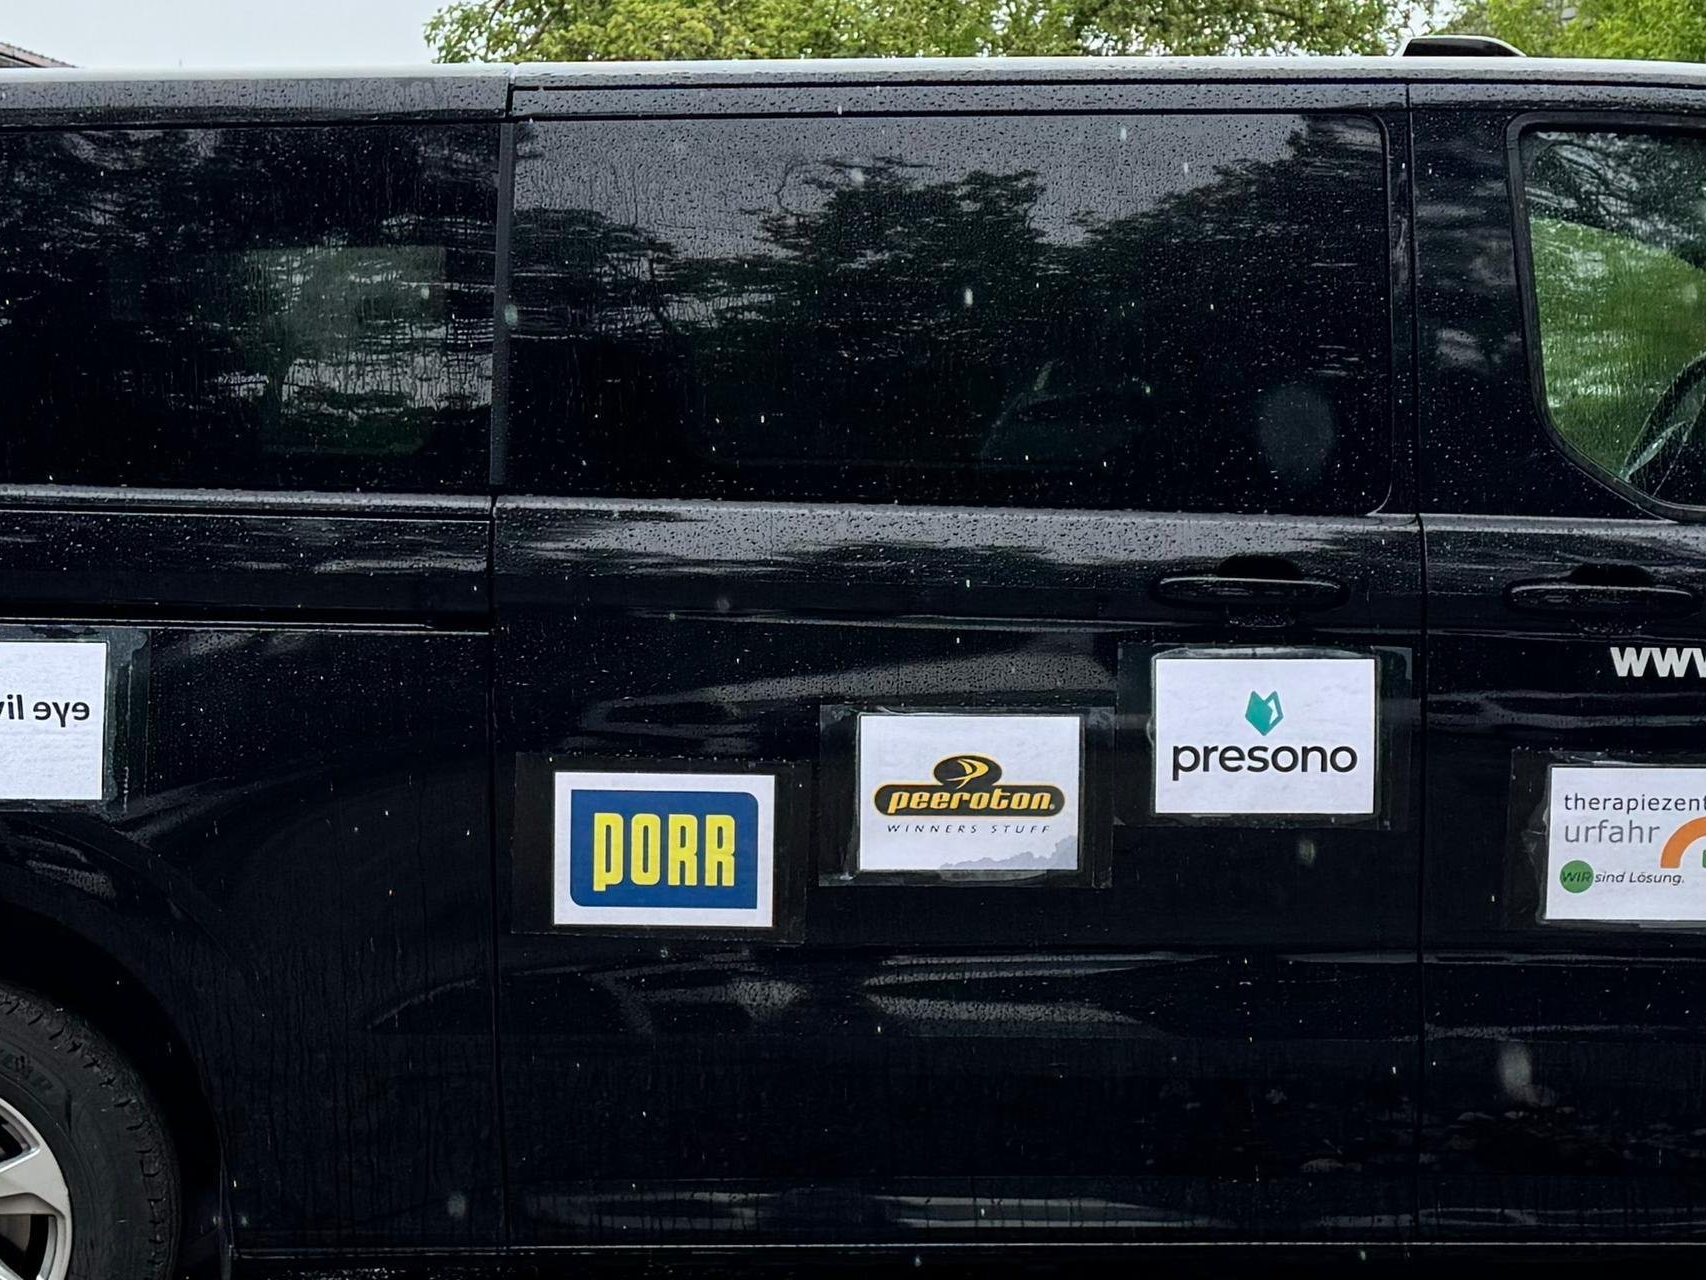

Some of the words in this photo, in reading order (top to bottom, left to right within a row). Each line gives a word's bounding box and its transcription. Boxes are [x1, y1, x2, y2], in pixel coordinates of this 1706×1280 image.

[1172, 741, 1357, 781] presono
[887, 824, 978, 834] WINNERS
[990, 824, 1053, 835] STUFF
[1564, 819, 1661, 844] urfahr
[592, 812, 736, 892] PORR
[1561, 871, 1593, 884] WIR
[1595, 872, 1625, 884] sind
[1629, 872, 1685, 886] Lösung.
